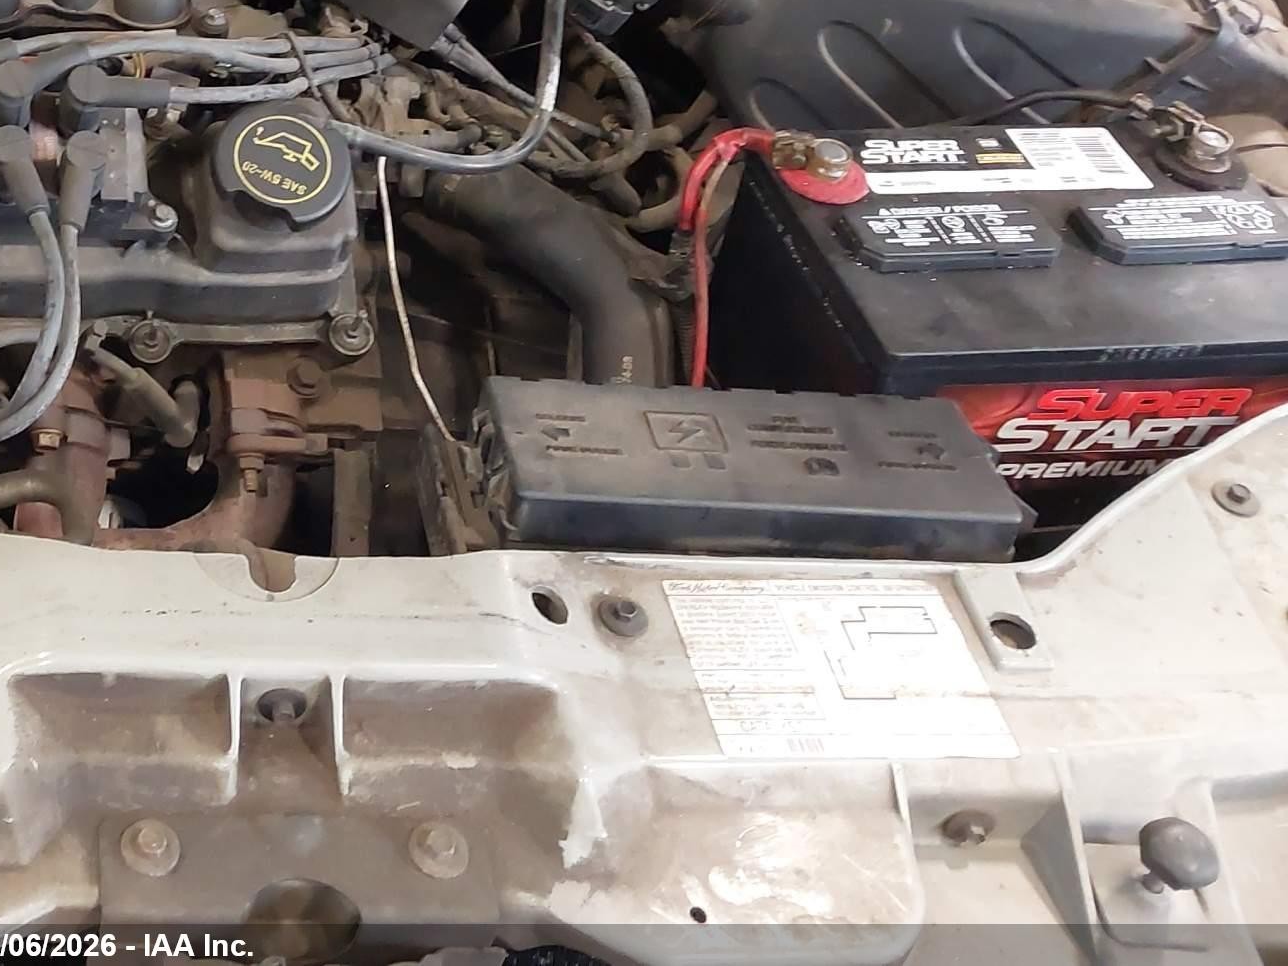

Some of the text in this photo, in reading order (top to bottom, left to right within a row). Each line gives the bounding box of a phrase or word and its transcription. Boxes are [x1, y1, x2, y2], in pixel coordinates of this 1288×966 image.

[860, 150, 965, 165] START
[864, 139, 960, 151] SUPER
[241, 161, 308, 195] SAE 5W-20
[1026, 388, 1253, 421] SUPER
[993, 416, 1240, 454] START
[995, 458, 1175, 480] PREMIUM
